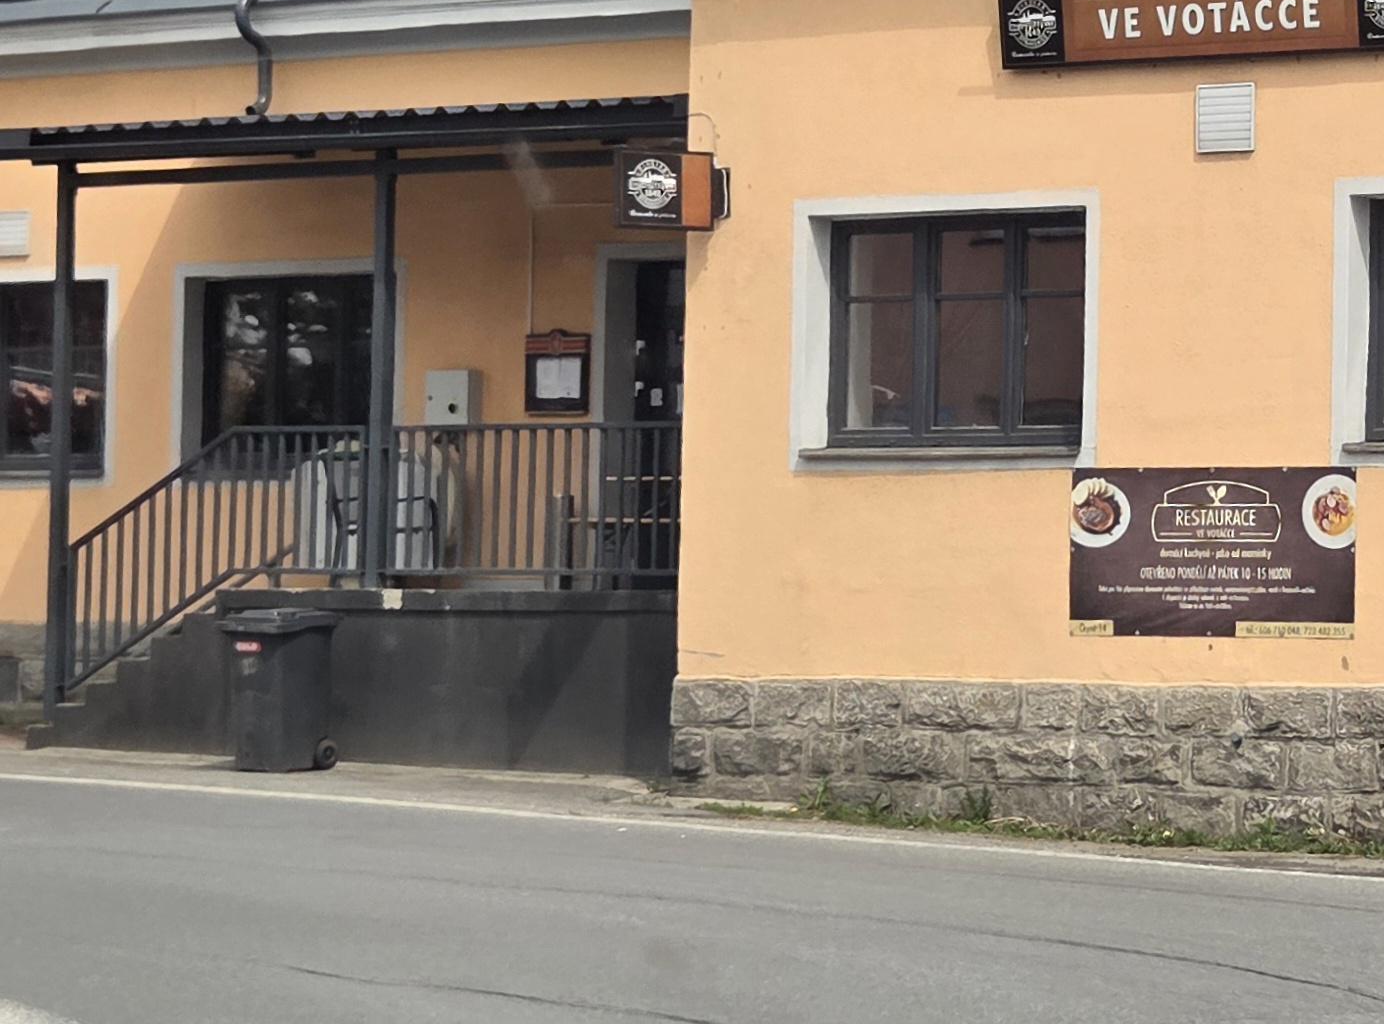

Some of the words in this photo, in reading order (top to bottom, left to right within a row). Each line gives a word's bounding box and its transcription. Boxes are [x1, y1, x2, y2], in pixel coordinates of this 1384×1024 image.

[1098, 6, 1142, 40] VE
[1175, 509, 1257, 526] RESTAURACE
[1140, 565, 1175, 579] OTEVŘENO
[1218, 564, 1239, 579] PÁTEK
[1242, 568, 1251, 579] 10
[1257, 567, 1266, 579] 15
